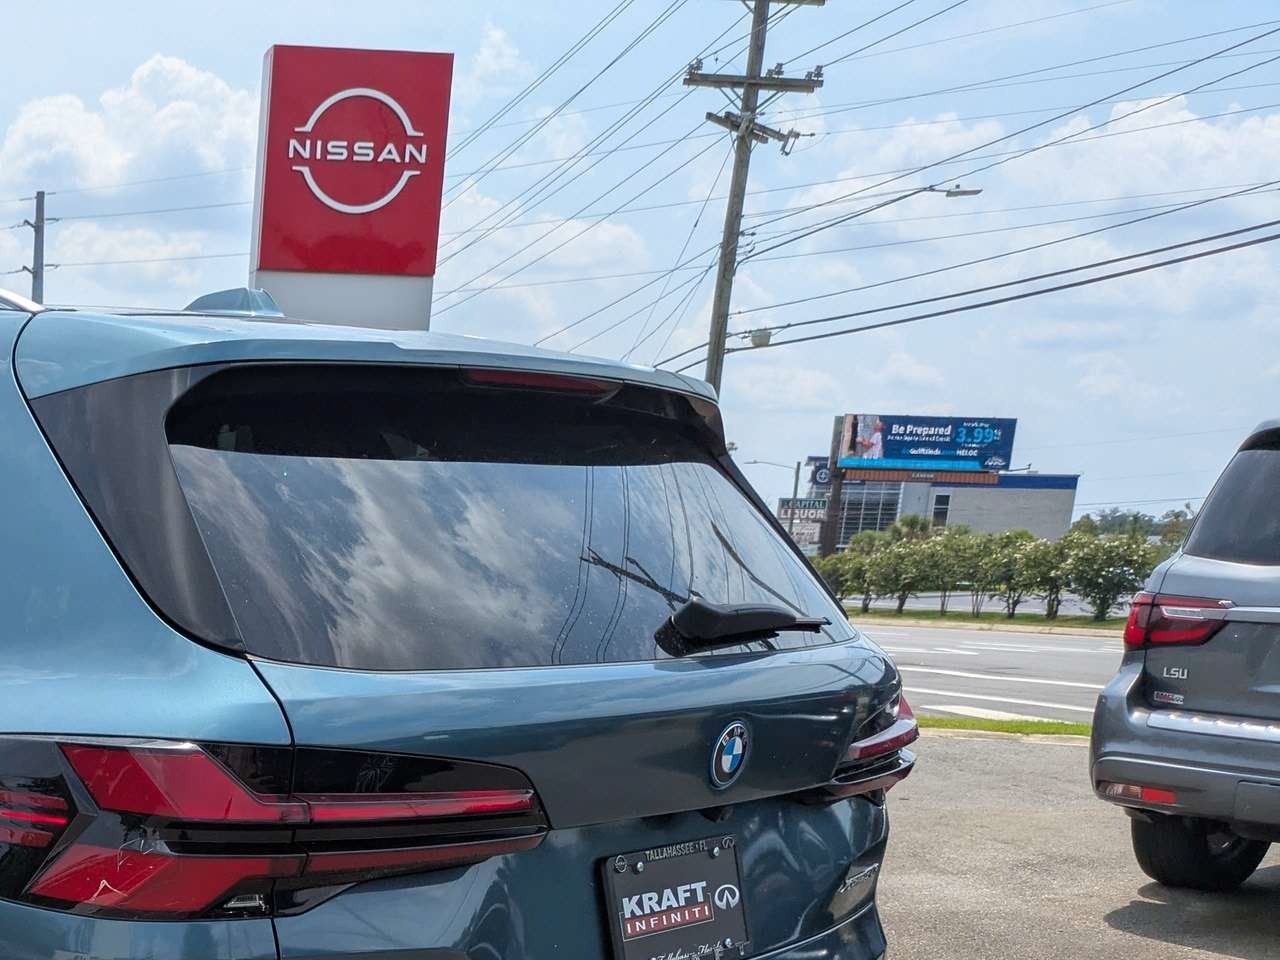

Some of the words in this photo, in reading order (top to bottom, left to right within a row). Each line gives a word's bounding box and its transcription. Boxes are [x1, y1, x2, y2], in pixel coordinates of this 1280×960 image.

[288, 138, 427, 164] NISSAN
[891, 424, 905, 434] Be
[906, 424, 952, 436] Prepared
[1163, 667, 1188, 680] LSU
[645, 843, 695, 861] TALLAHASSEE
[622, 881, 707, 918] KRAFT
[626, 906, 709, 934] INFINITI
